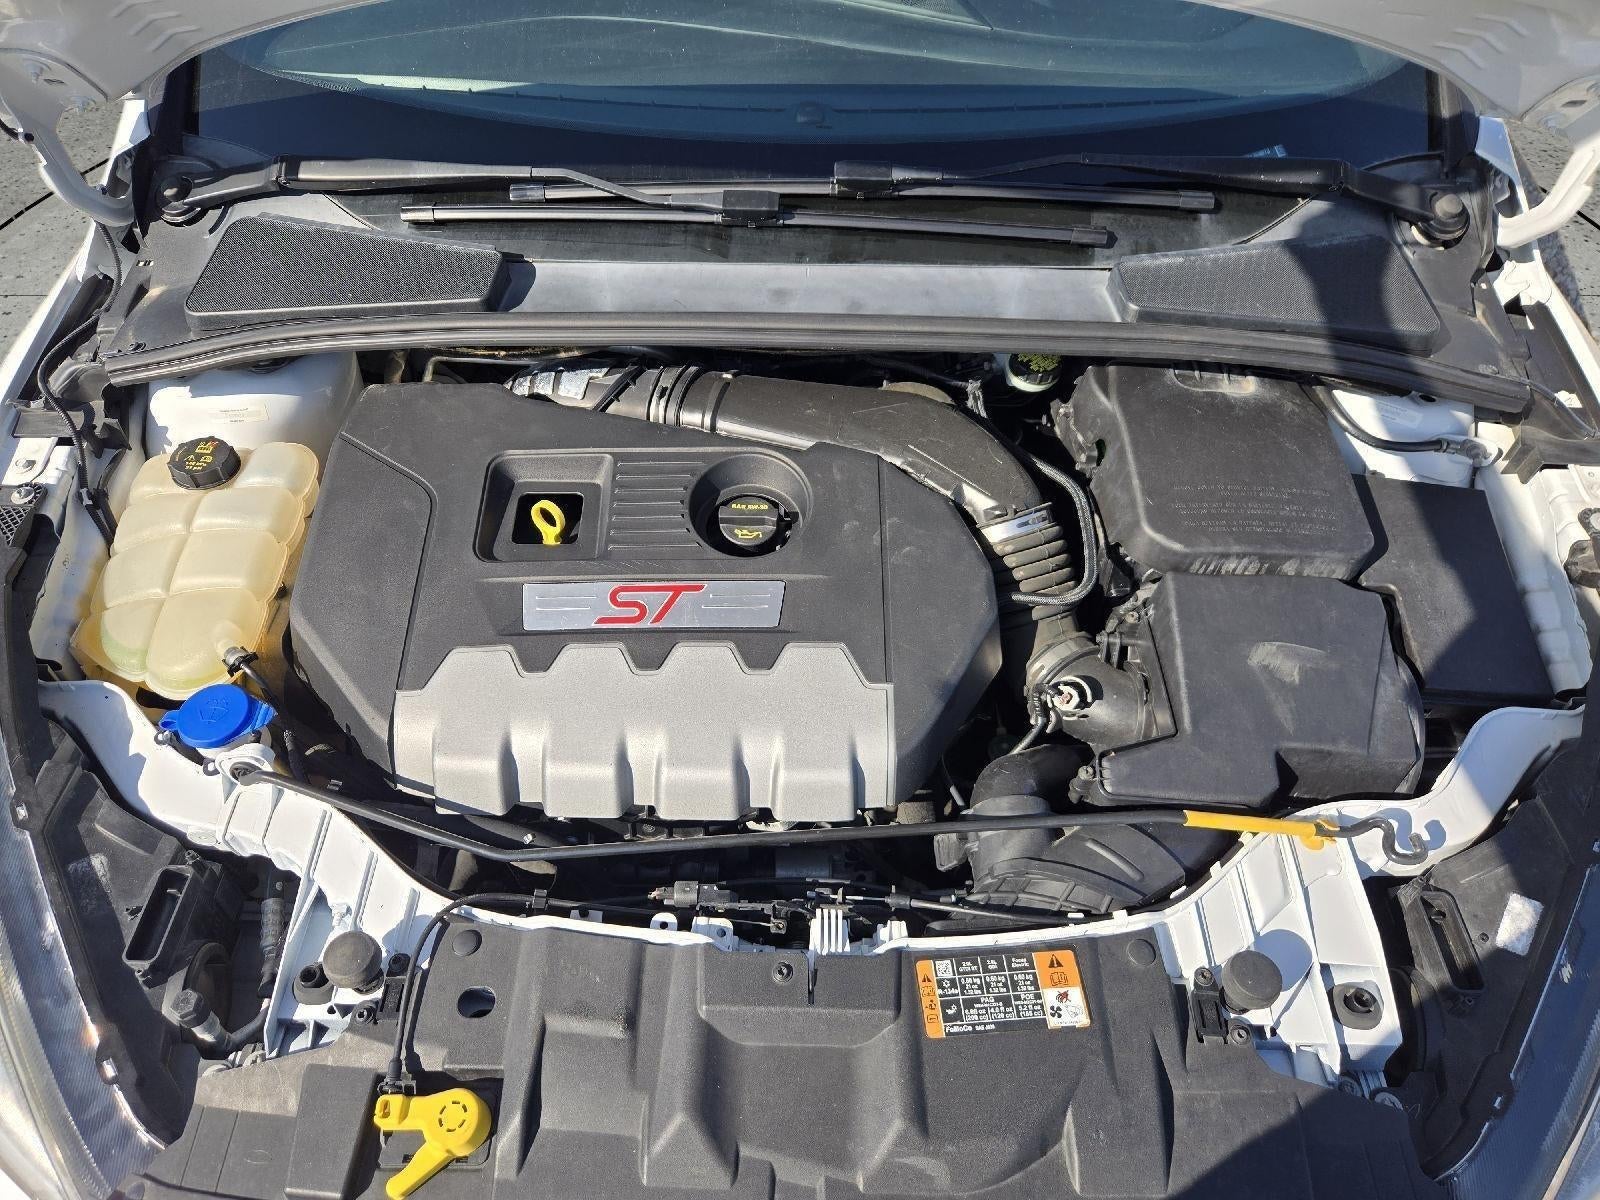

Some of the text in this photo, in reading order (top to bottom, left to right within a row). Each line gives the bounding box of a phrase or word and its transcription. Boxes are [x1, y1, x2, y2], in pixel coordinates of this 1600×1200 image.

[592, 583, 708, 626] ST
[1026, 973, 1033, 981] kg
[945, 1025, 973, 1033] FoMoCo
